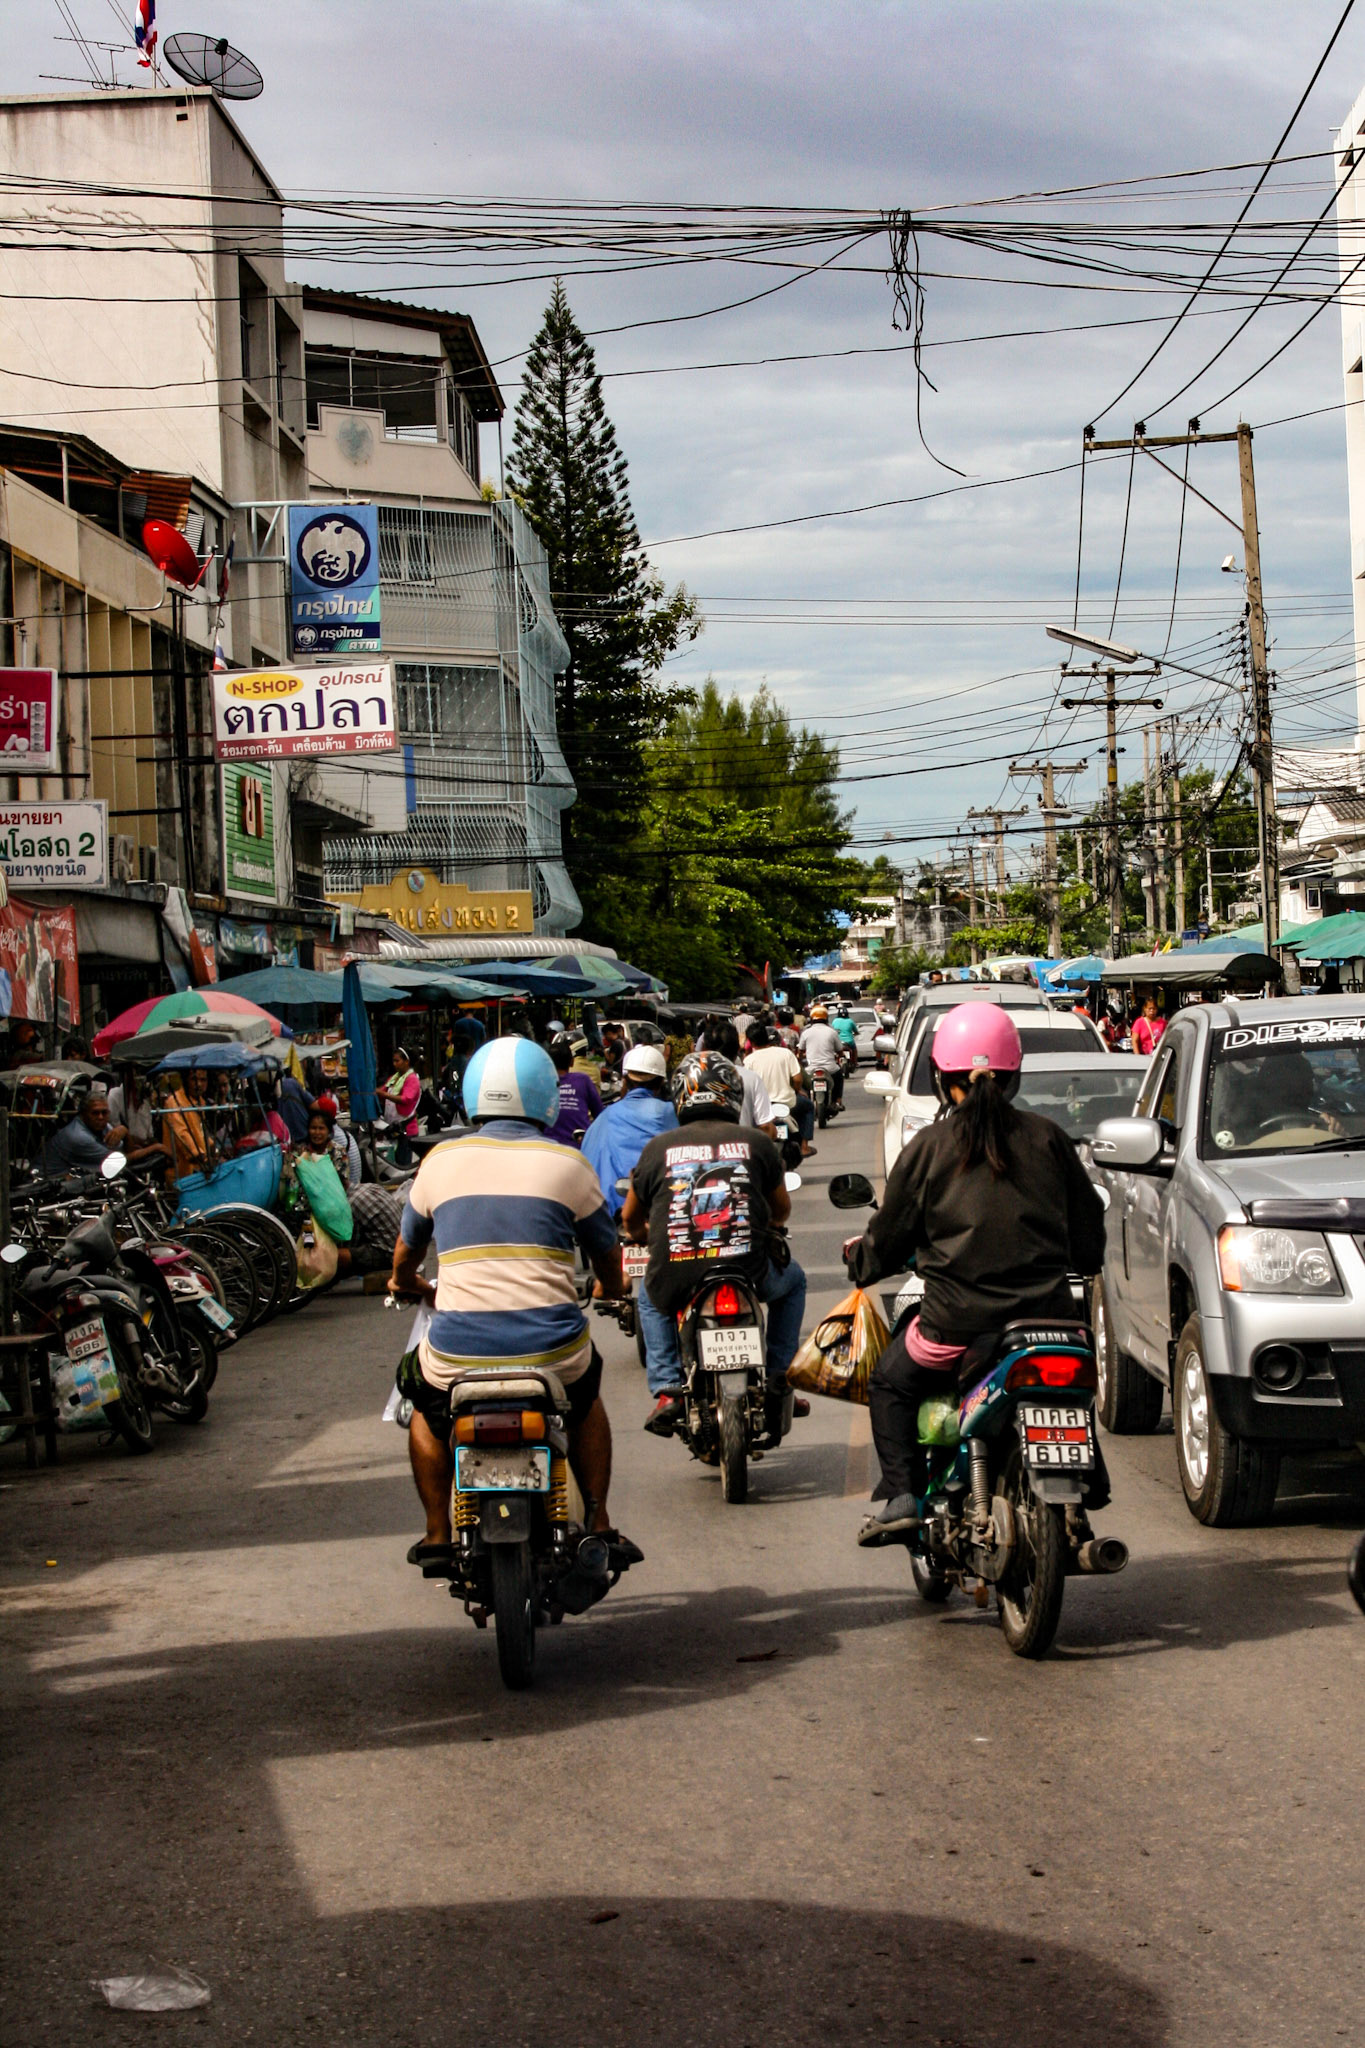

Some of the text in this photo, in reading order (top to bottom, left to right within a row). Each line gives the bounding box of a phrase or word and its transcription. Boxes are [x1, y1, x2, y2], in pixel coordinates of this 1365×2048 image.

[297, 594, 373, 620] กรุงไทย
[320, 626, 363, 640] กรุงไทย
[348, 641, 378, 650] ATM
[232, 680, 298, 695] N-SHOP
[319, 668, 384, 690] อุปกรณ์
[223, 689, 387, 735] ตกปลา
[79, 832, 96, 856] 2
[506, 905, 520, 928] 2
[694, 1093, 713, 1101] INDEX
[665, 1142, 751, 1167] THUNDER ALLEY
[714, 1330, 748, 1342] กจว
[1024, 1333, 1069, 1343] YAMAHA
[1036, 1446, 1082, 1463] 619
